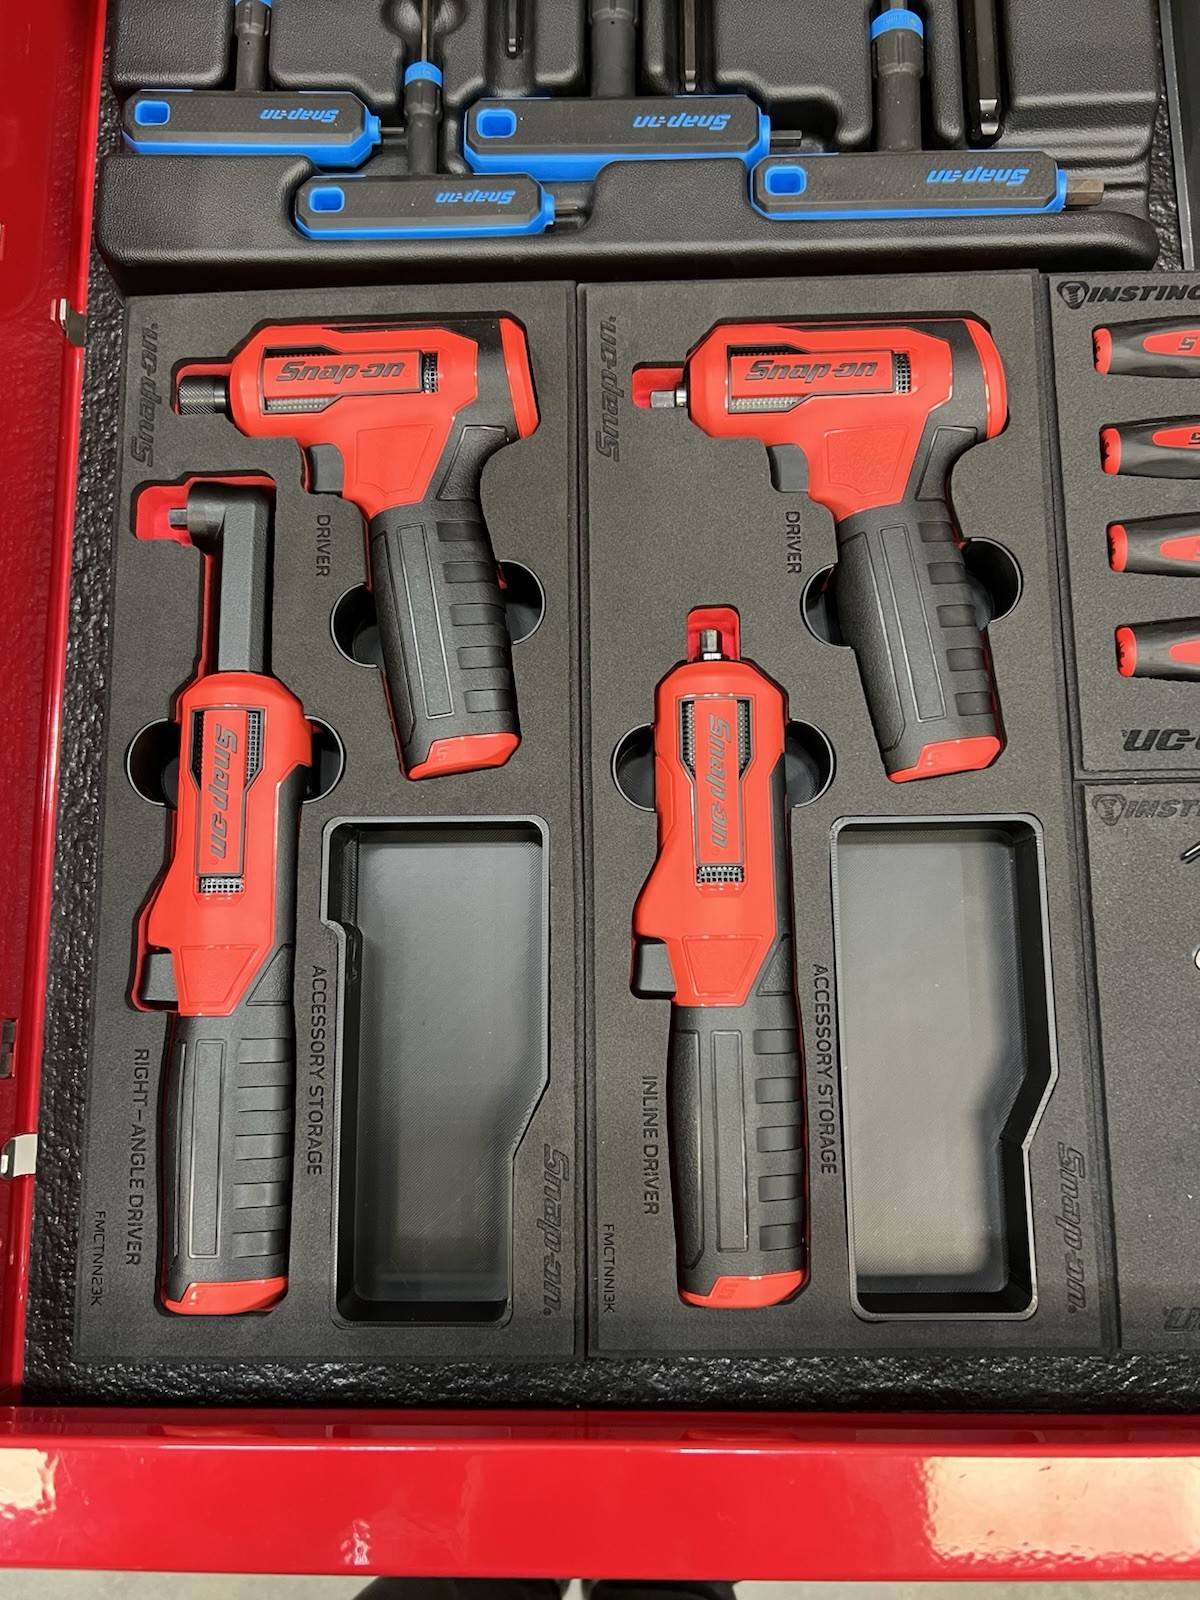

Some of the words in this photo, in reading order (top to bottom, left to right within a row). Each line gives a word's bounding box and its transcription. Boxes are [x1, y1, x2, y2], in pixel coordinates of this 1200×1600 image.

[260, 108, 339, 123] Snap-on
[632, 113, 731, 132] Snap-on
[436, 189, 517, 205] Snap-on
[926, 166, 1030, 187] Snap-on
[130, 323, 161, 468] Snap-on
[276, 361, 405, 384] Snap-on
[595, 317, 623, 462] Snap-on
[745, 359, 878, 382] Snap-on
[316, 514, 332, 578] DRIVER
[785, 510, 801, 574] DRIVER
[209, 724, 238, 859] Snap-on
[706, 713, 732, 848] Snap-on
[310, 966, 327, 1080] ACCESSORY
[814, 963, 833, 1081] ACCESSORY
[306, 1085, 324, 1175] STORAGE
[642, 1075, 659, 1139] INLINE
[817, 1084, 838, 1175] STORAGE
[643, 1143, 660, 1215] DRIVER
[90, 1211, 106, 1306] FMCTNN23K
[126, 1193, 143, 1265] DRIVER
[537, 1144, 570, 1311] Snap-on
[1054, 1142, 1086, 1310] Snap-on
